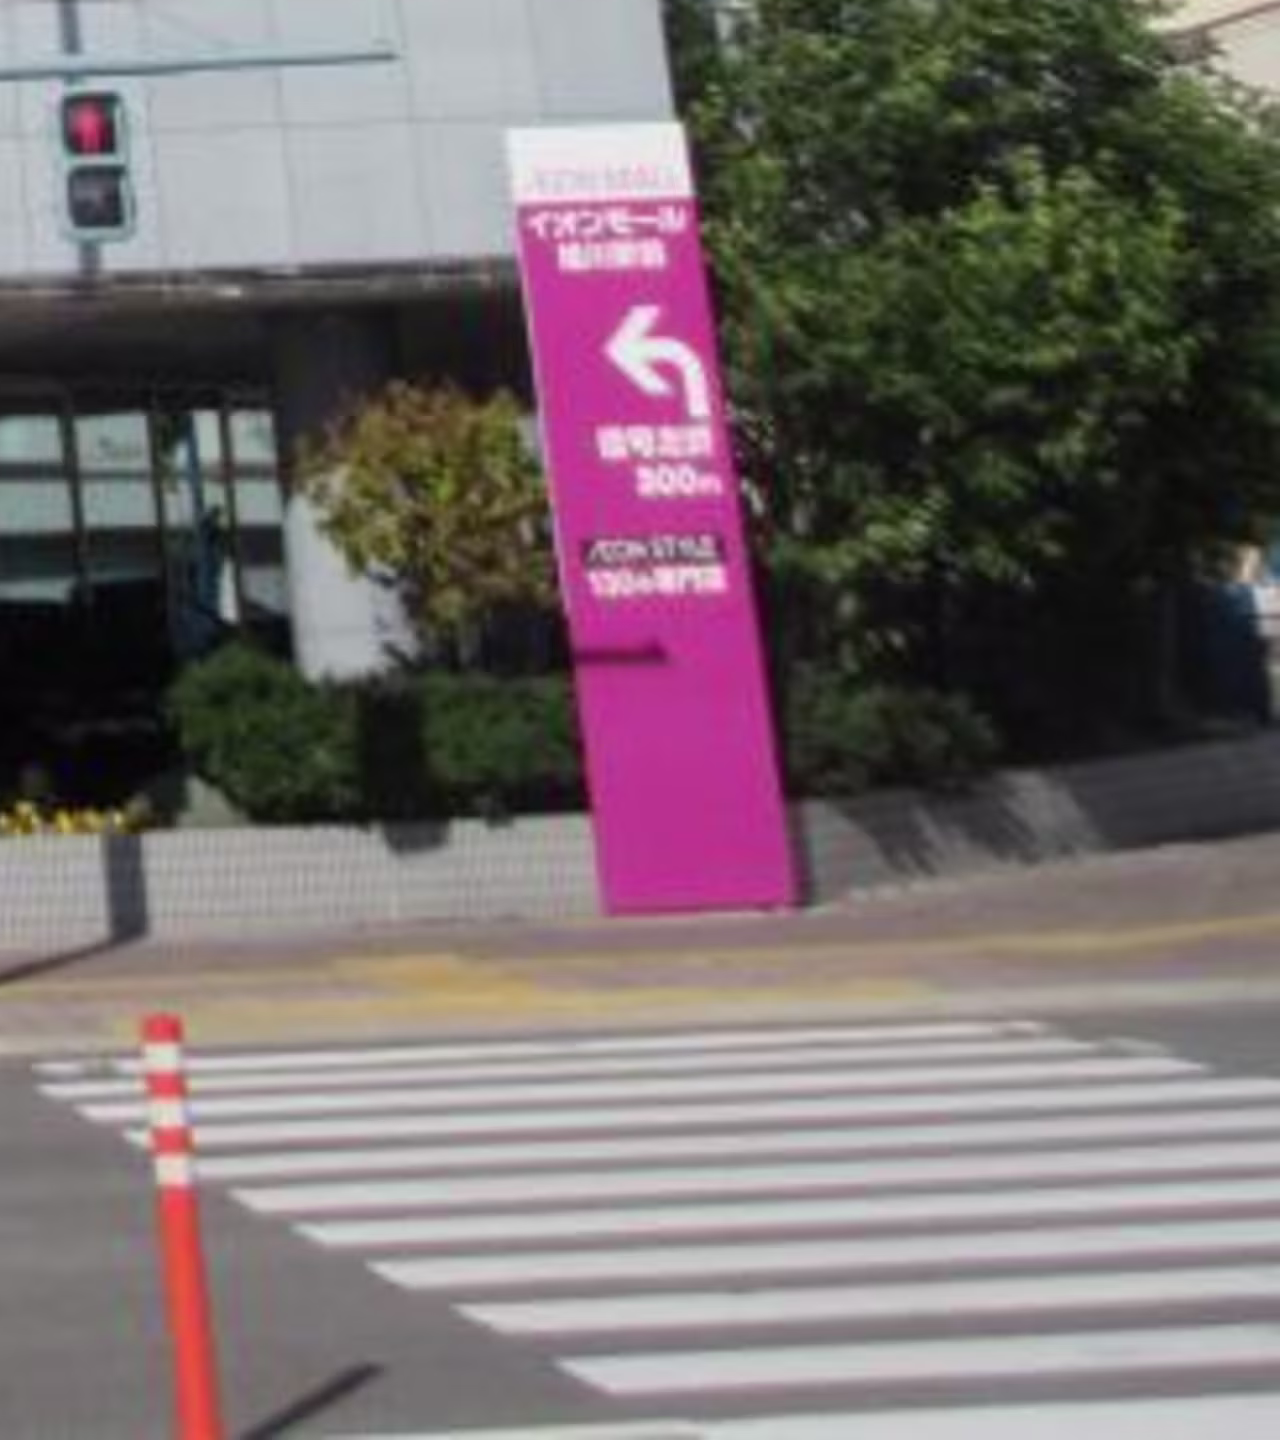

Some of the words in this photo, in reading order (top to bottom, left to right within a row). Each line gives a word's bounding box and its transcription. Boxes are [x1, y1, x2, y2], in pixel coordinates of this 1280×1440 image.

[528, 205, 687, 241] イオンモール
